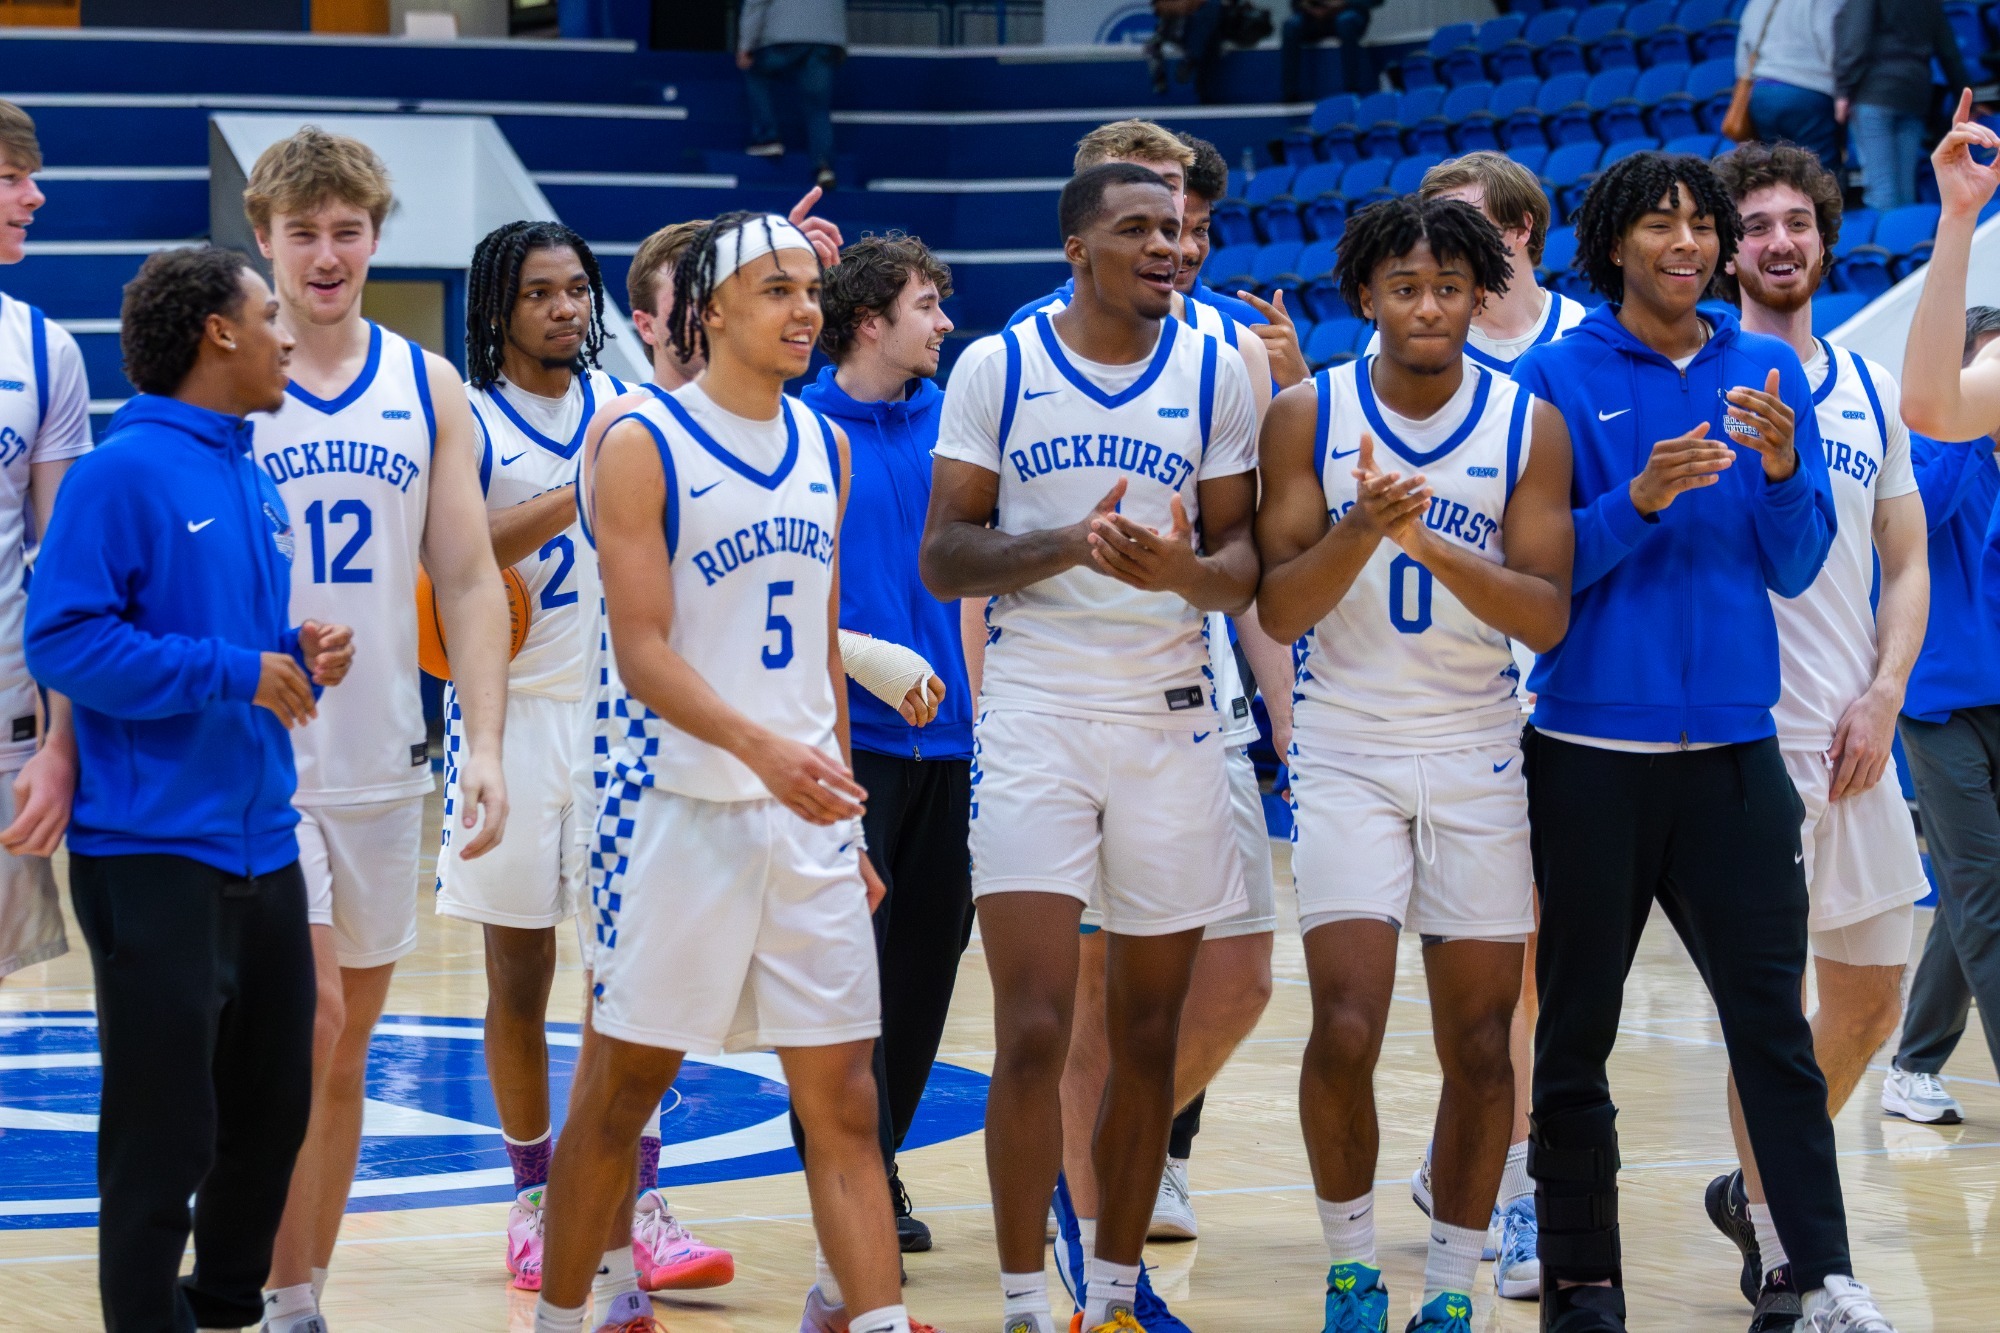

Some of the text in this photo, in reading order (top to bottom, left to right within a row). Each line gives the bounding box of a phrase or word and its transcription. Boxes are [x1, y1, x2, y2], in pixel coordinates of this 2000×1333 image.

[263, 440, 420, 494] OCKHURST
[1009, 434, 1195, 492] ROCKHURST
[1726, 424, 1760, 436] UNIVERS
[305, 500, 373, 583] 12
[539, 534, 579, 610] 2
[761, 580, 794, 670] 5
[1389, 552, 1433, 634] 0
